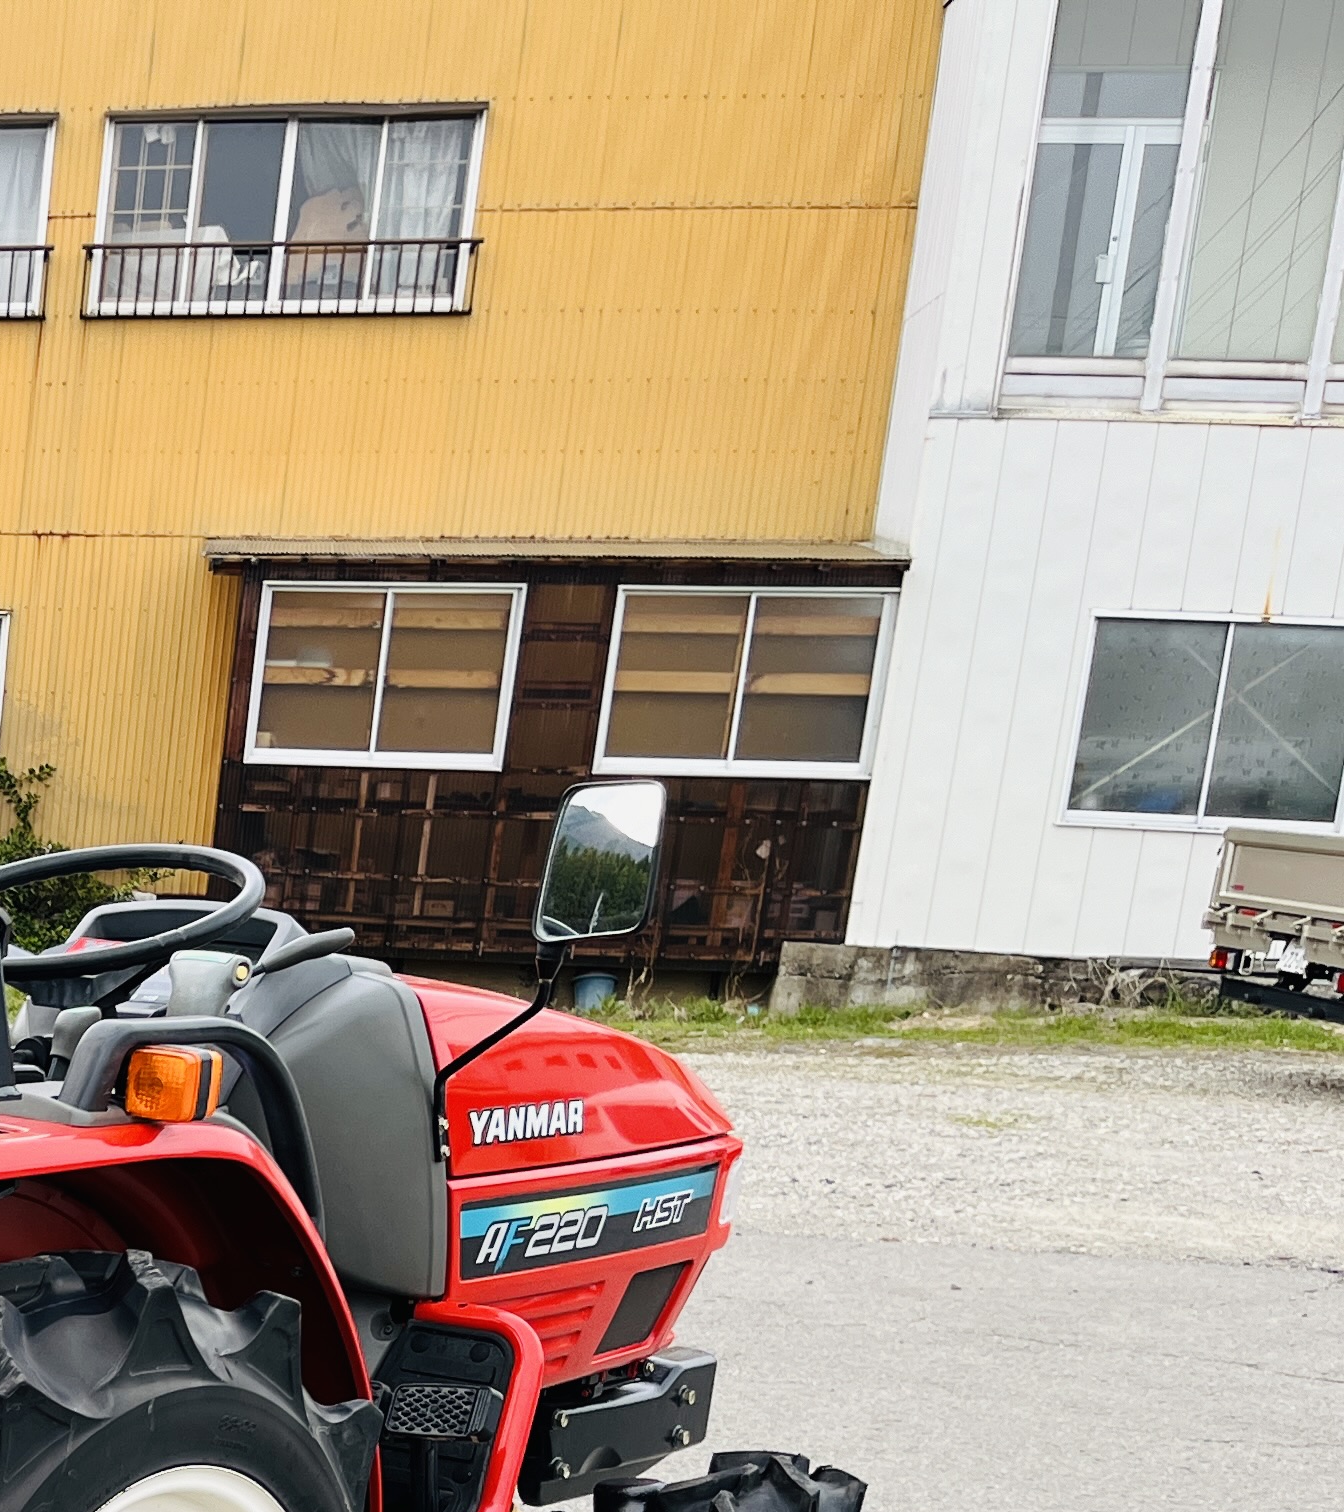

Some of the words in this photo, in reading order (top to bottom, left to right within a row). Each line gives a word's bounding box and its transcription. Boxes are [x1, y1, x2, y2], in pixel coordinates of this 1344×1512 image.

[469, 1099, 584, 1146] YANMAR
[475, 1204, 609, 1274] AF220
[632, 1189, 695, 1233] HST
